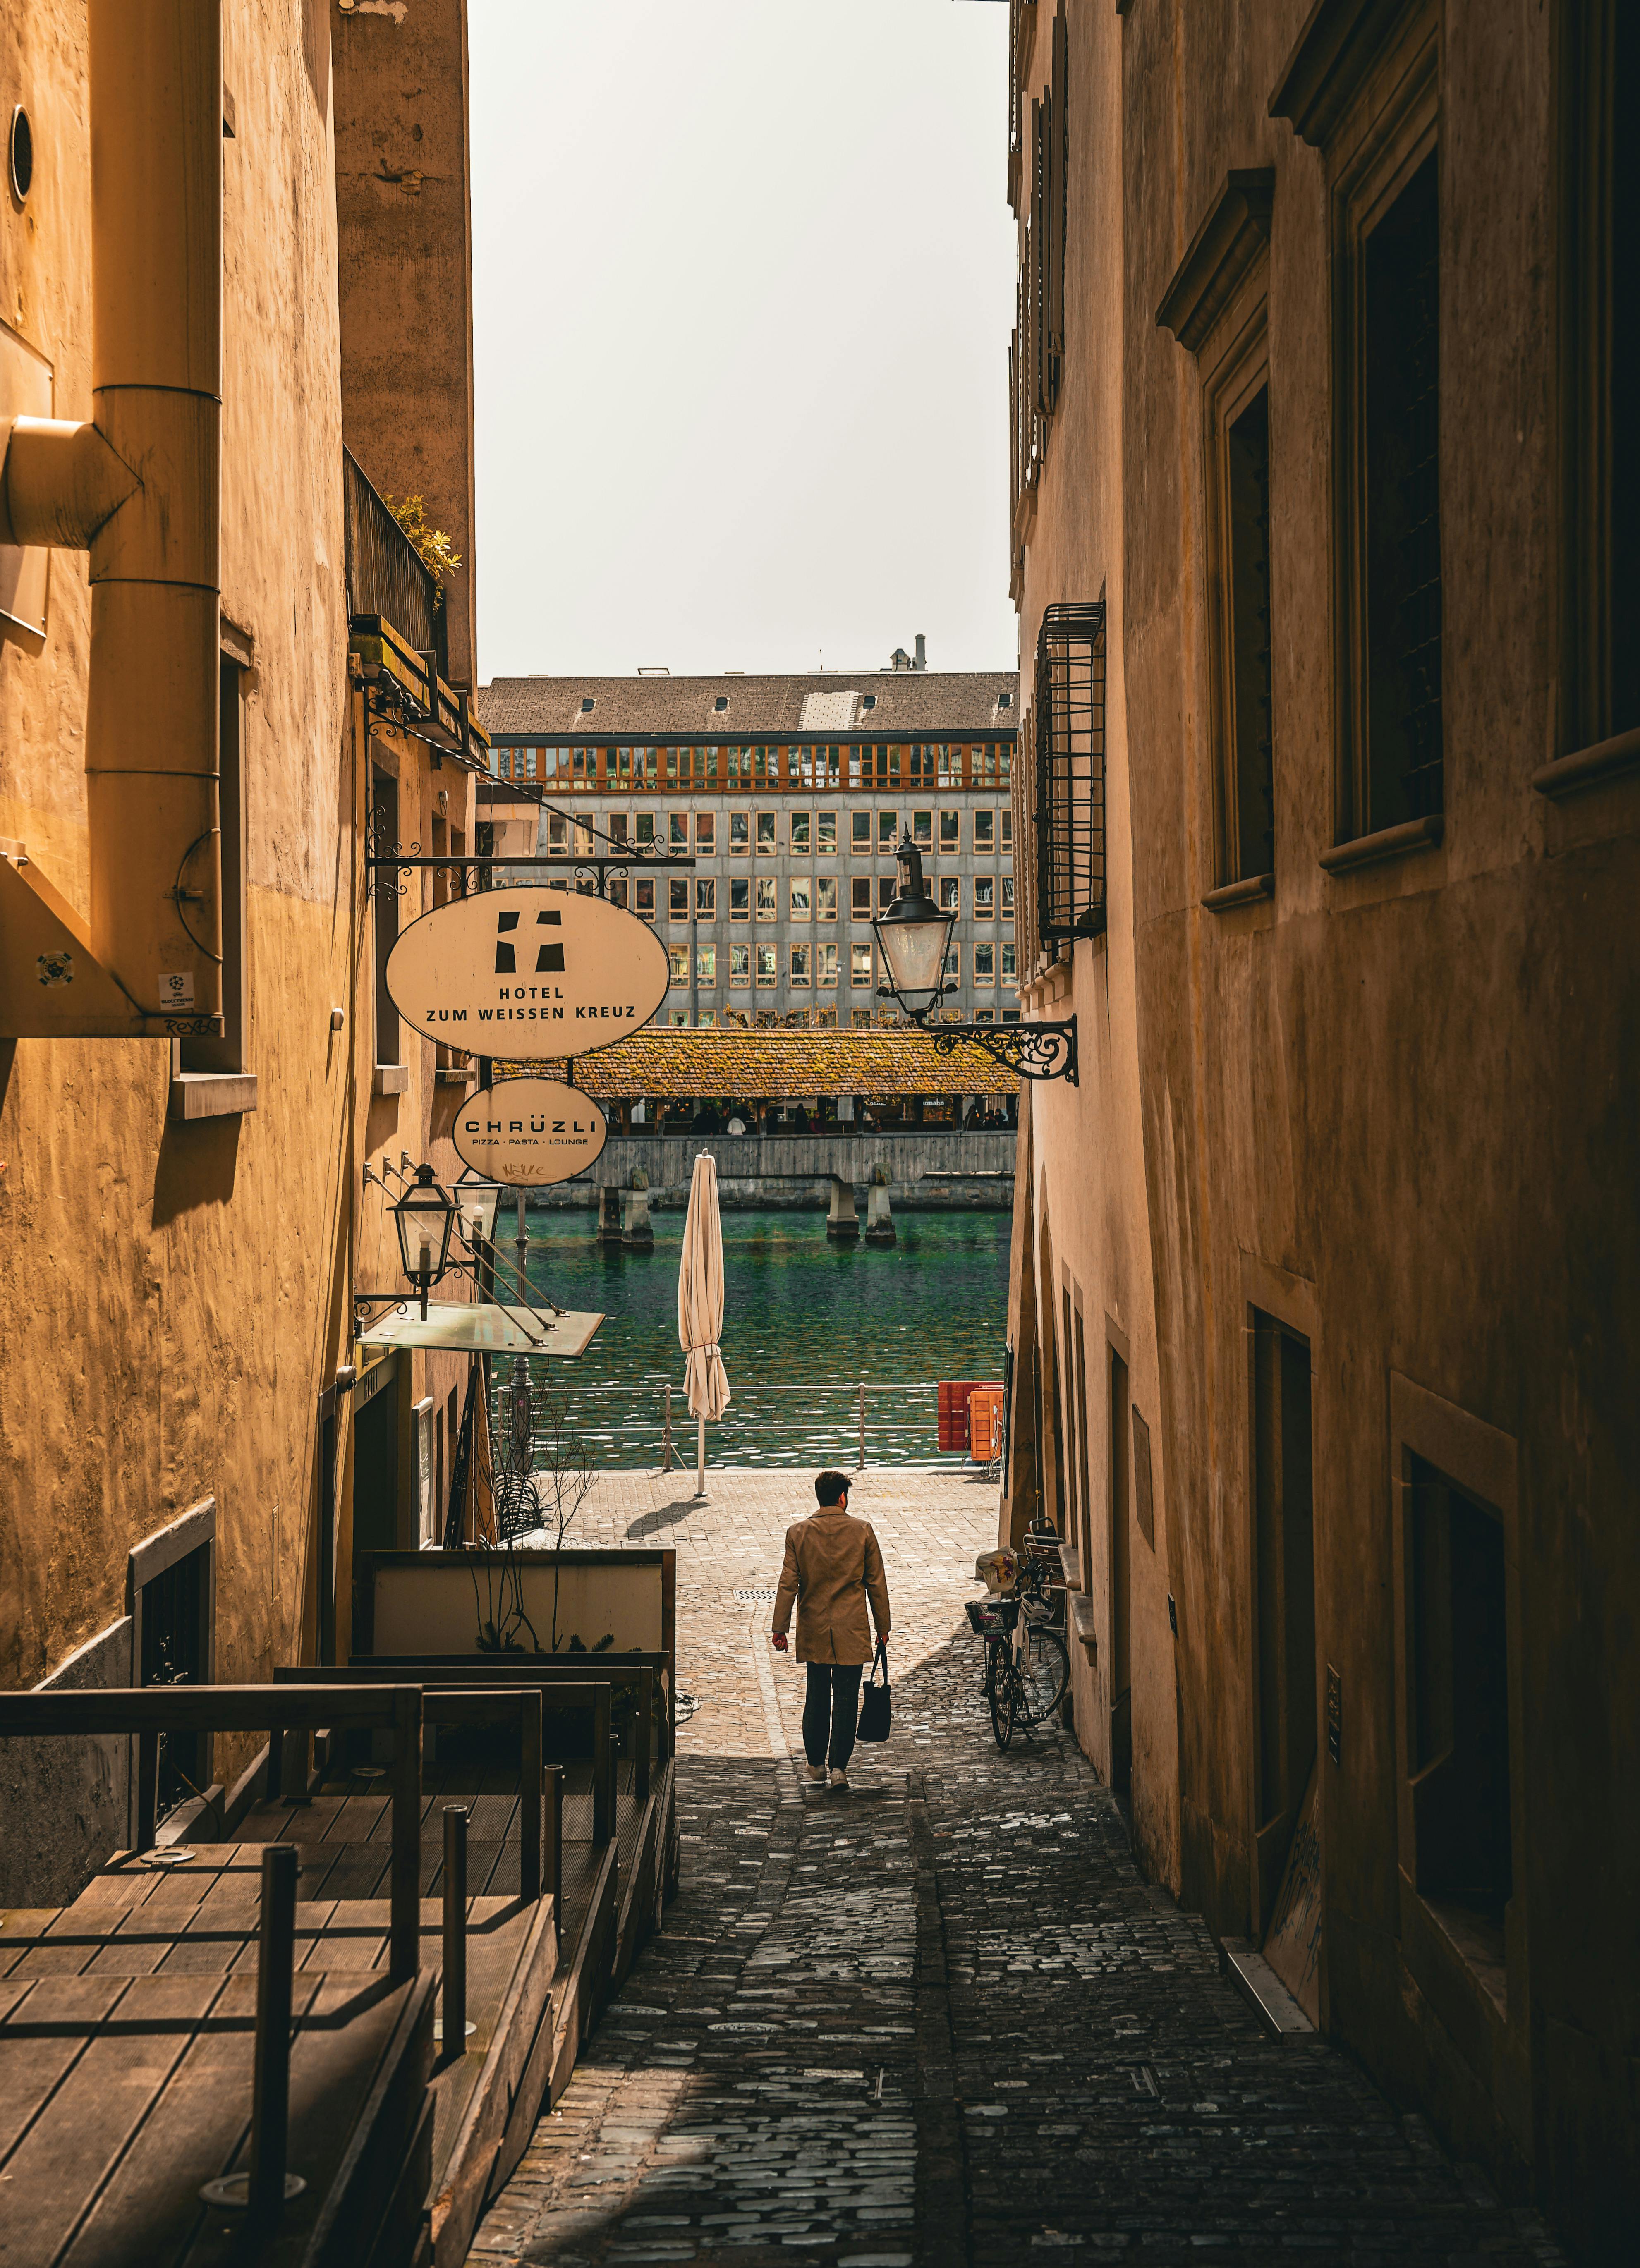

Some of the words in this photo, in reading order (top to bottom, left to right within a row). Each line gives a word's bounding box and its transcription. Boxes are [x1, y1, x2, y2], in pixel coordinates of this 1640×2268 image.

[500, 987, 563, 1000] HOTEL
[426, 1010, 467, 1022] ZUM
[478, 1007, 564, 1020] WEISSEN
[575, 1006, 635, 1018] KREUZ
[465, 1115, 595, 1132] CHRÜZLI
